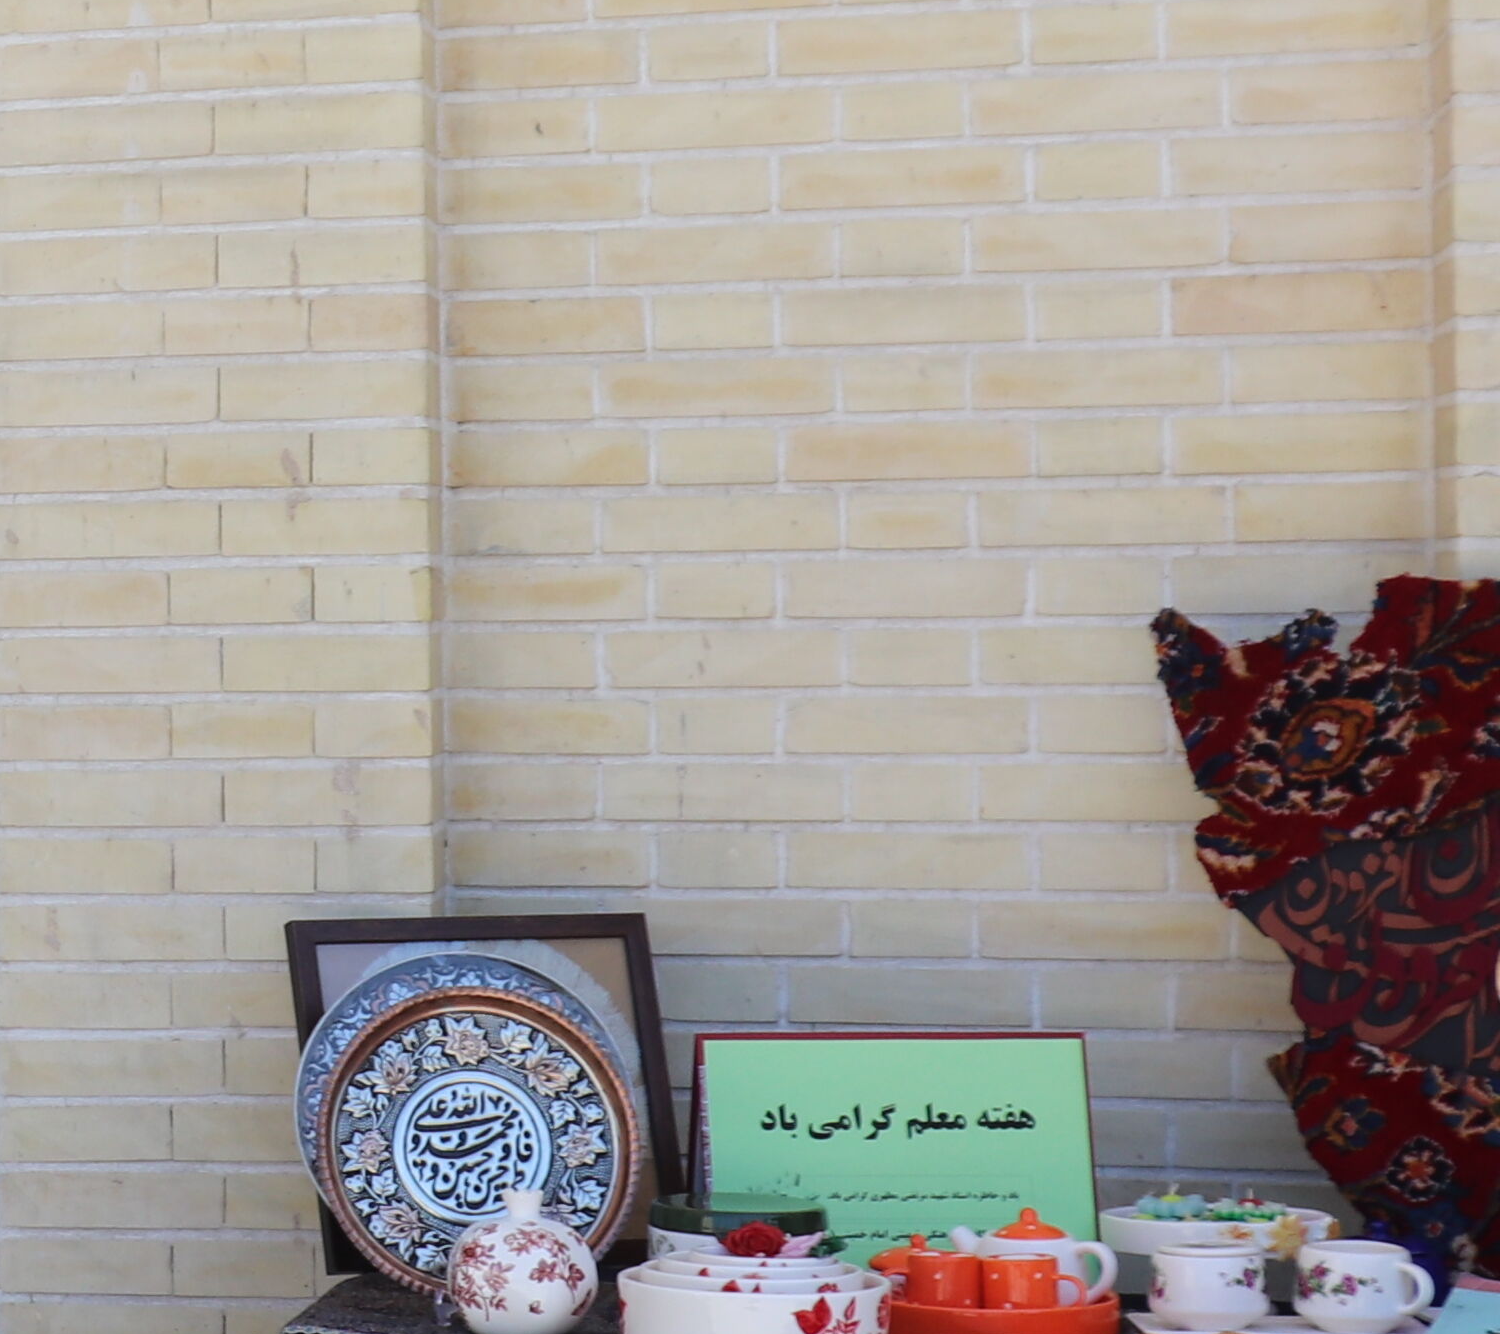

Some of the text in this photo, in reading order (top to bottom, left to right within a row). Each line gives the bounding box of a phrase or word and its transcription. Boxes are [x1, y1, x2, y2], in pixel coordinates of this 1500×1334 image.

[760, 1103, 1036, 1140] هفته معلم گرامی باد
